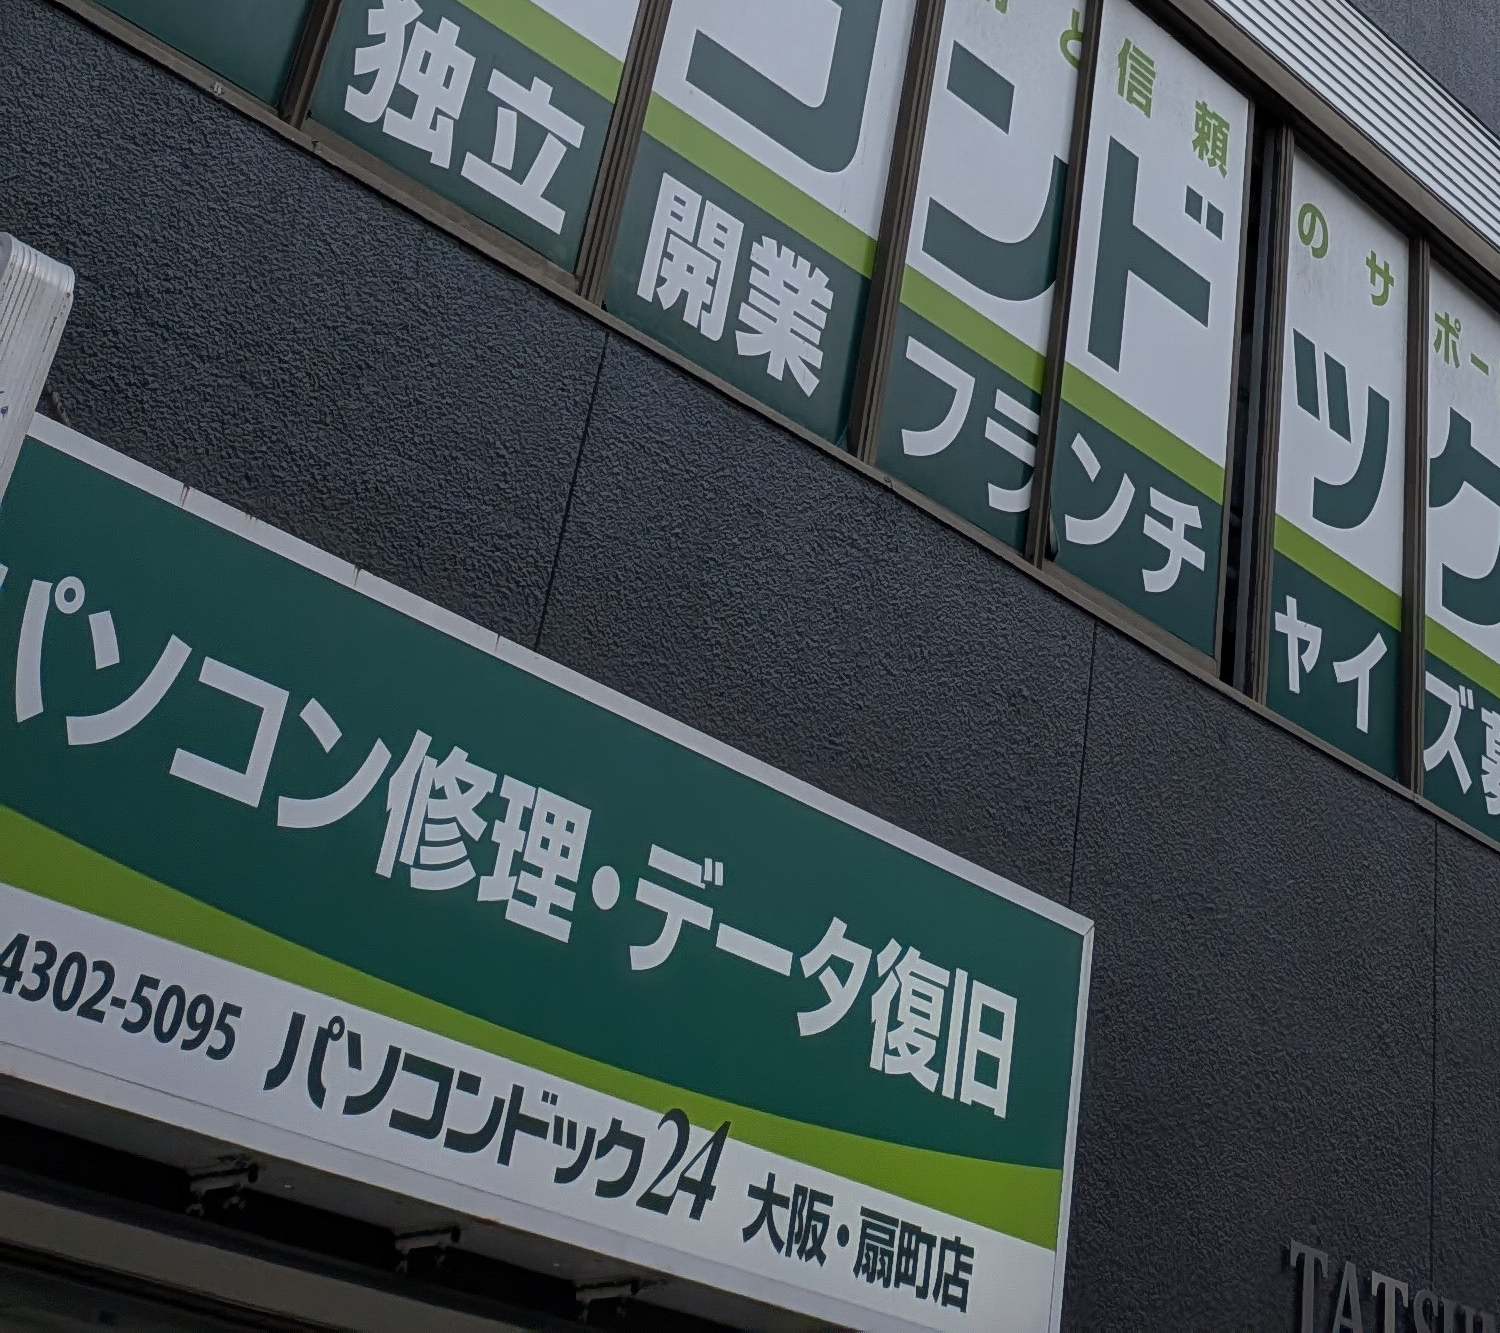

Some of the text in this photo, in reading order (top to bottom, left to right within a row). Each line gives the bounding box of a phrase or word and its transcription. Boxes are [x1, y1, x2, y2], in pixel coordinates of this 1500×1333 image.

[263, 1011, 733, 1222] パソコンドック24
[742, 1172, 976, 1313] 大阪・扇町店
